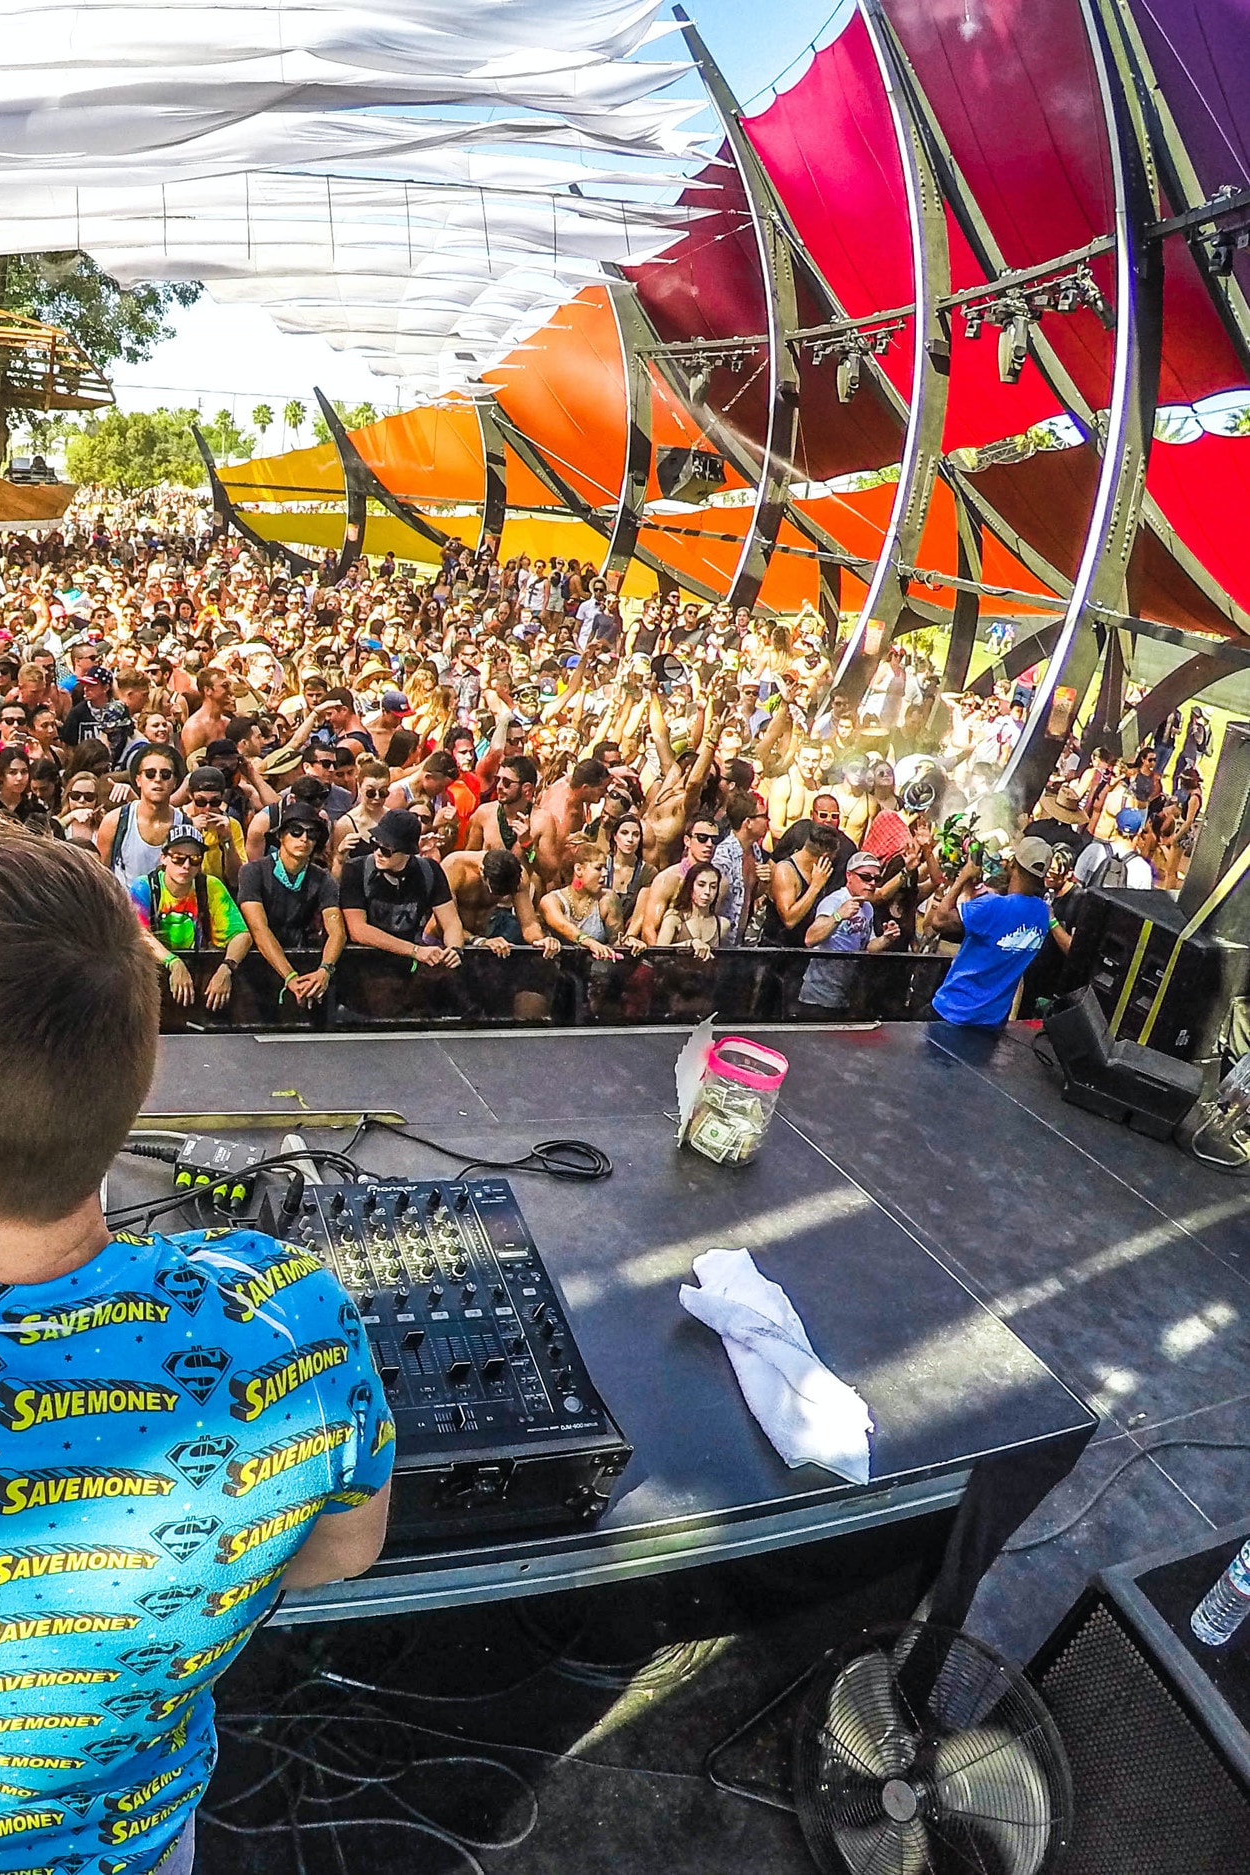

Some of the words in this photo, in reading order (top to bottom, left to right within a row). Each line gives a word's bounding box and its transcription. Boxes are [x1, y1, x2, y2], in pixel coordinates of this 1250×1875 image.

[366, 1184, 418, 1193] Pioneer
[19, 1302, 170, 1345] SAVEMONEY
[246, 1346, 349, 1422] SAVEMONEY
[11, 1389, 179, 1431] SAVEMONEY
[235, 1427, 354, 1497] SAVEMONEY
[2, 1475, 178, 1515] SAVEMONEY
